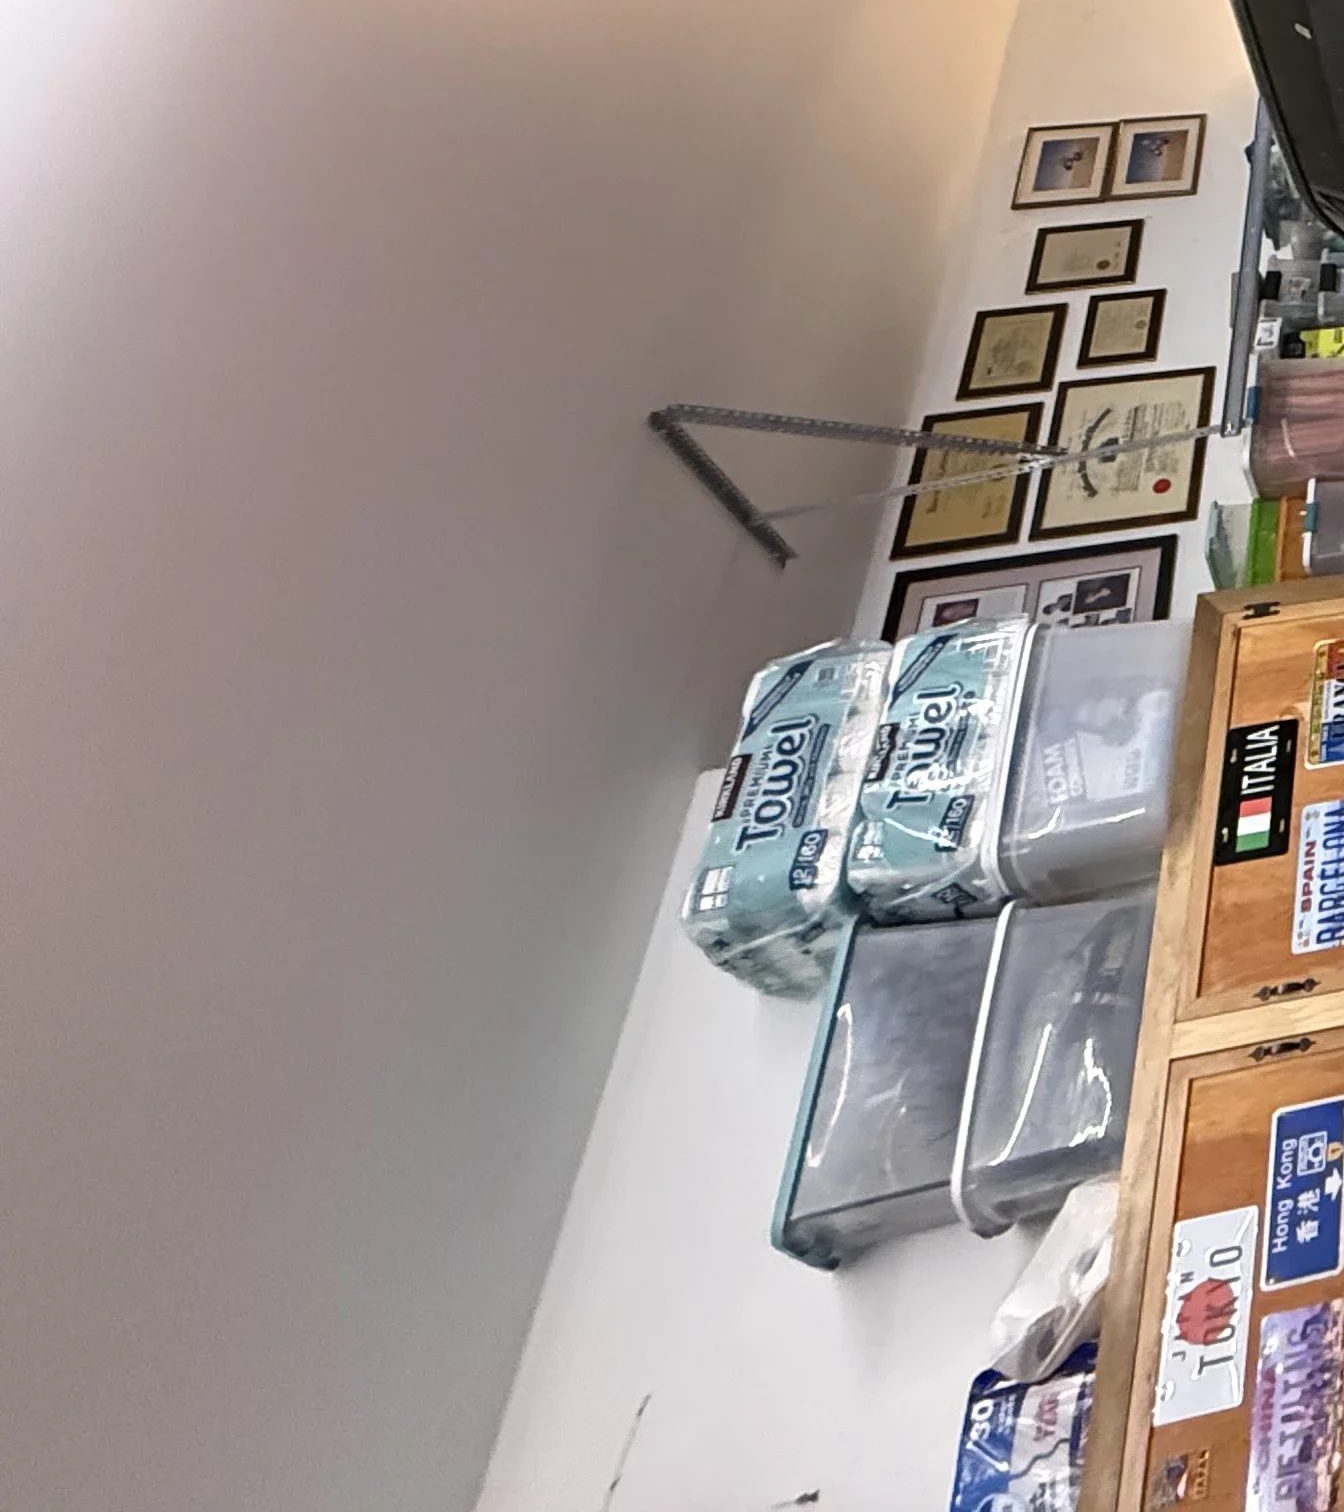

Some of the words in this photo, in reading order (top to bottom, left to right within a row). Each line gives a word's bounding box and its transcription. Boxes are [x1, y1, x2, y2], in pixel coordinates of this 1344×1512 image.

[736, 716, 812, 850] Towel
[740, 750, 771, 818] PREMIUM
[1043, 742, 1068, 804] FOAM
[1240, 724, 1280, 796] ITALIA
[798, 832, 821, 862] 160
[1301, 840, 1317, 913] SPAIN
[1276, 1138, 1298, 1190] Kong
[1271, 1199, 1294, 1253] Hong
[1295, 1187, 1321, 1244] 香港
[1171, 1270, 1196, 1362] JAPAN
[1197, 1245, 1243, 1375] TOKYO
[968, 1398, 994, 1440] 30
